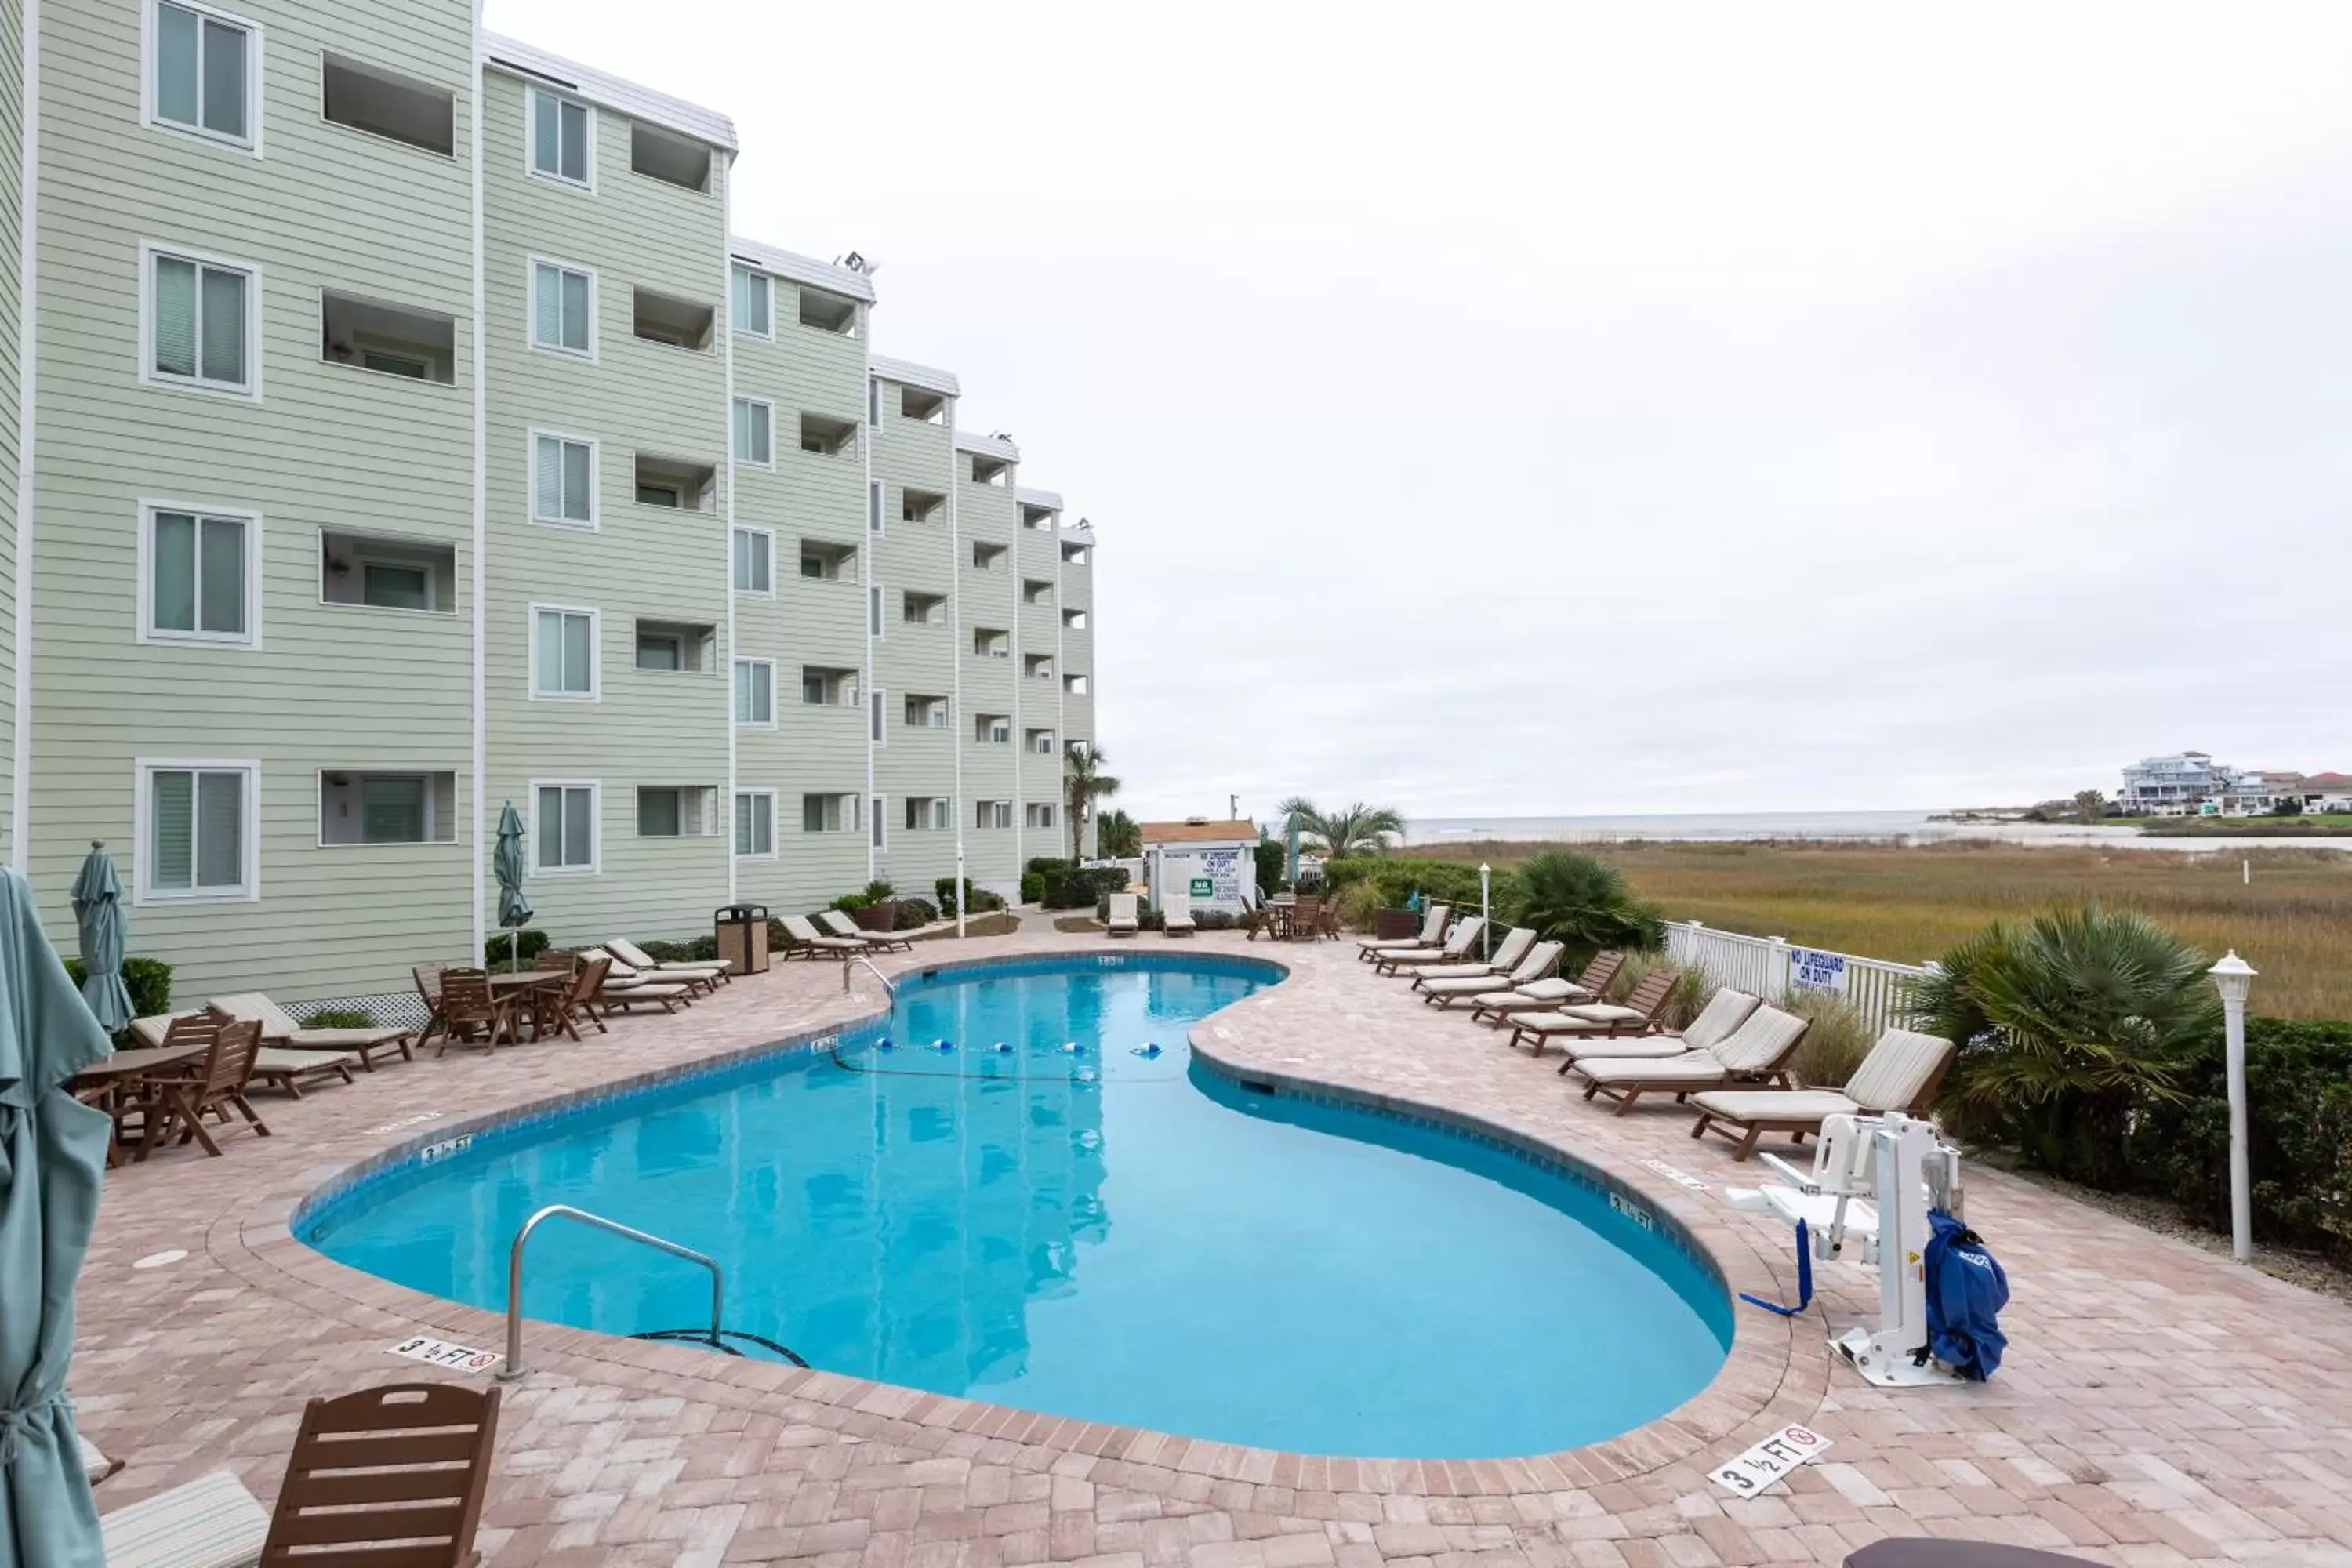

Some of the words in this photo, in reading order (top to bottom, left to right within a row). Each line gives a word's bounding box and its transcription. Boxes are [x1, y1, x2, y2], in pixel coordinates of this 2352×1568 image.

[1791, 949, 1802, 964] NO
[1804, 951, 1844, 973] LIFEGUARD
[1800, 965, 1810, 980] ON
[1813, 968, 1833, 985] DUTY
[398, 1339, 426, 1352] 3
[435, 1348, 476, 1365] FT
[1722, 1469, 1755, 1489] 3
[1761, 1438, 1803, 1463] FT
